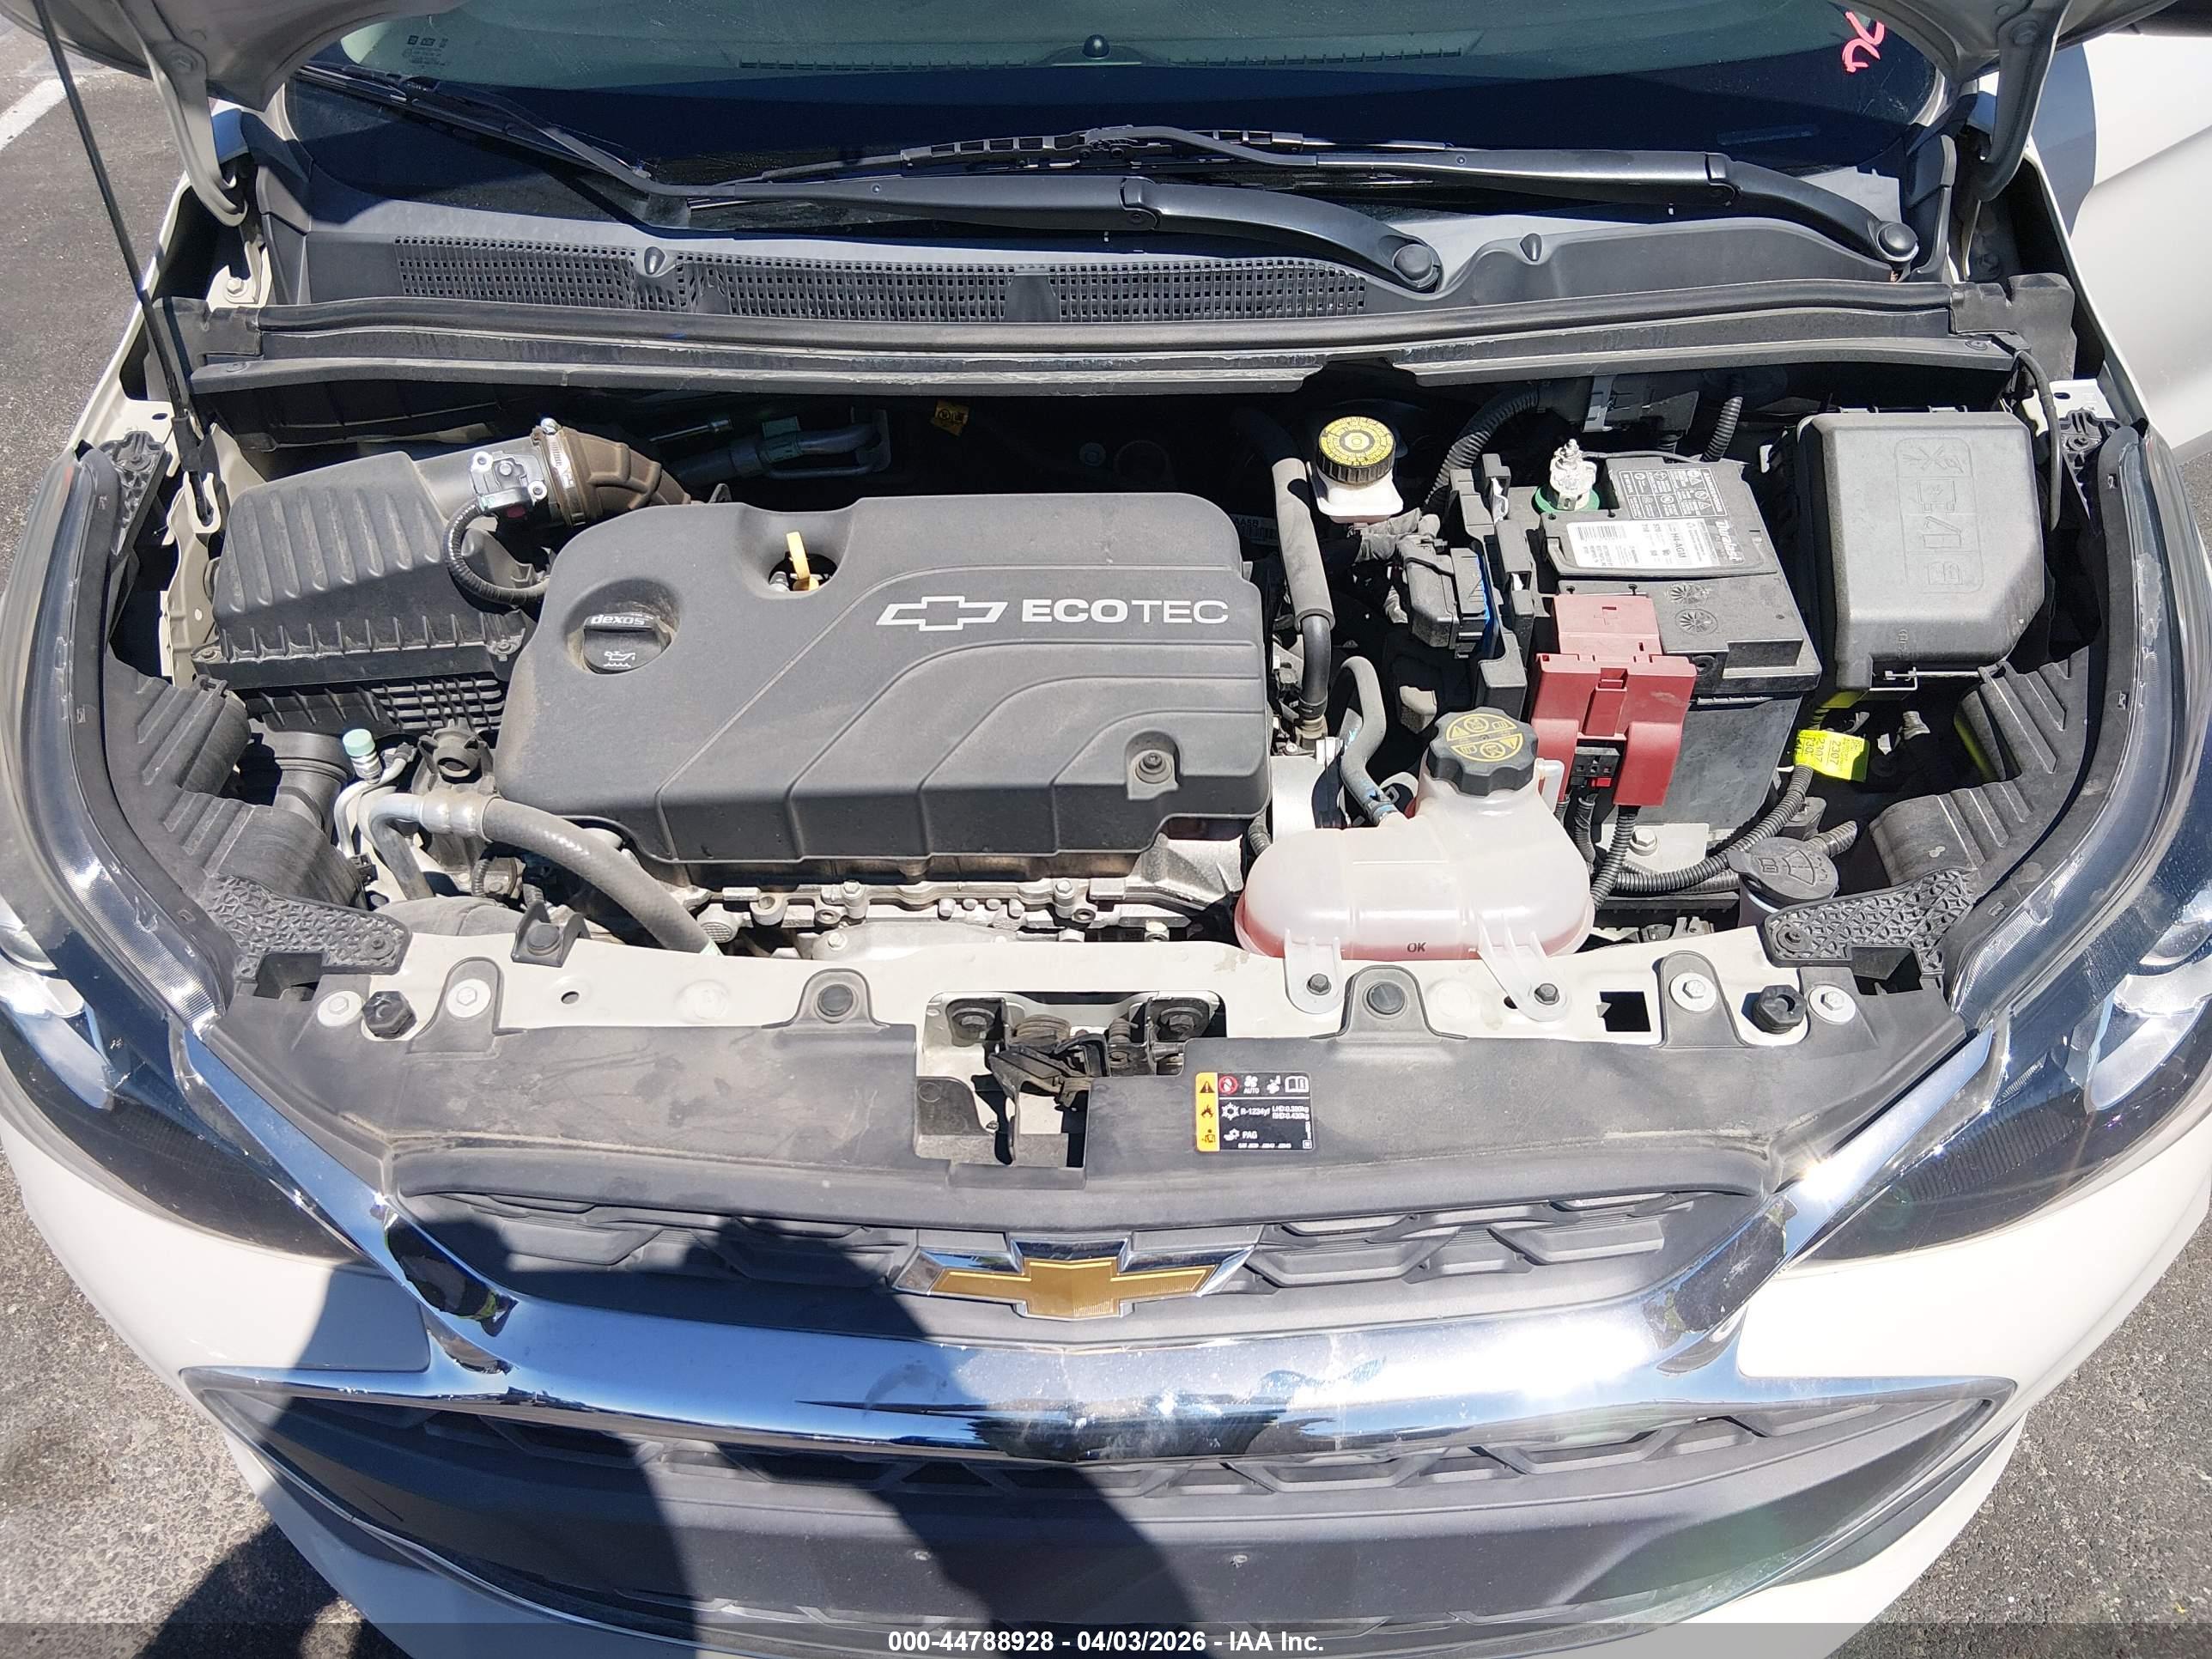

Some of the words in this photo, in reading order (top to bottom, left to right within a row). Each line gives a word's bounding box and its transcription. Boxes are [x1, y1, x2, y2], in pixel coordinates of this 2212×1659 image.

[1669, 533, 1686, 557] H4-AGM
[1714, 520, 1741, 561] Duralast
[590, 614, 645, 626] dexos
[1021, 599, 1229, 624] ECOTEC
[1830, 740, 1842, 766] 2307
[1407, 942, 1426, 952] OK
[1242, 1131, 1258, 1139] PAG
